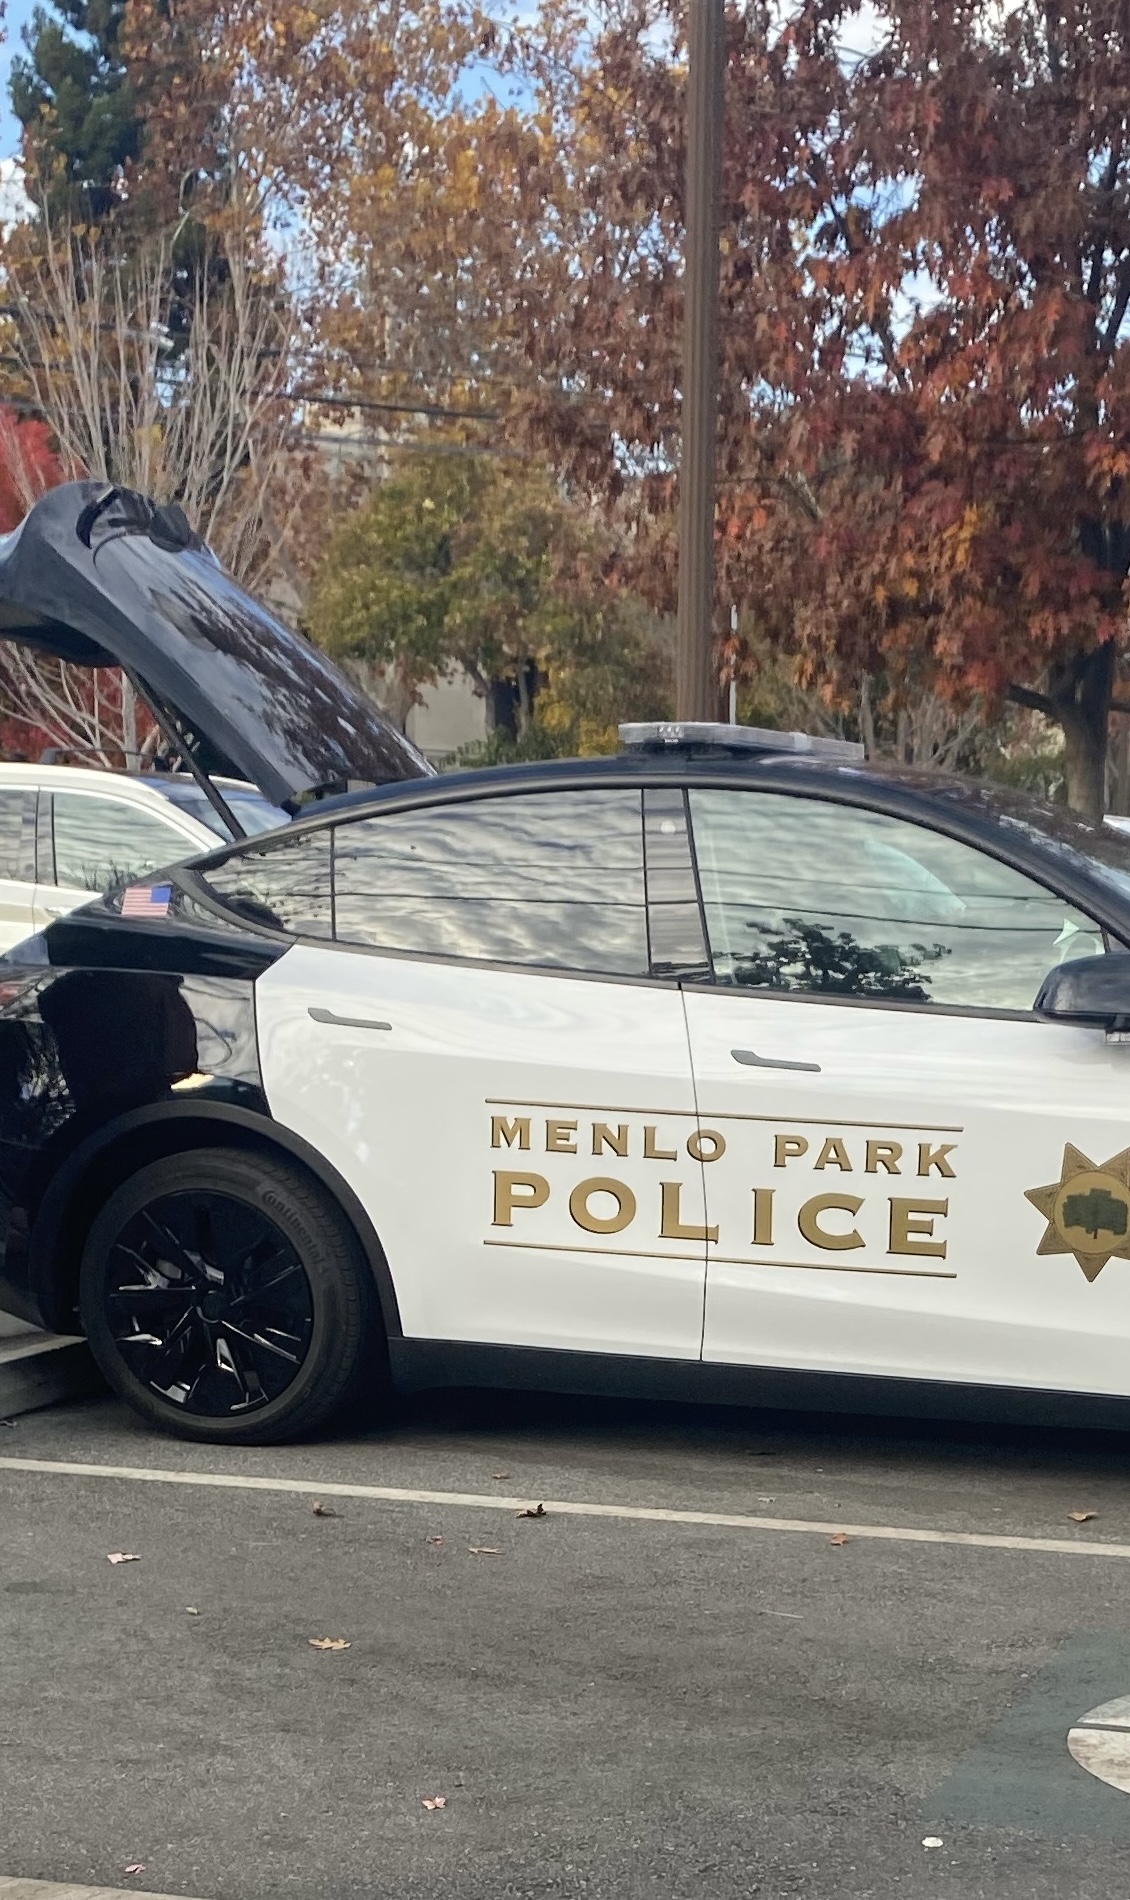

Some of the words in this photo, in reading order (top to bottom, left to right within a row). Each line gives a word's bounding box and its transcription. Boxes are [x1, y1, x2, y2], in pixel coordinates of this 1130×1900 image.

[490, 1115, 726, 1162] MENLO
[773, 1134, 959, 1178] PARK
[491, 1170, 949, 1260] POLICE
